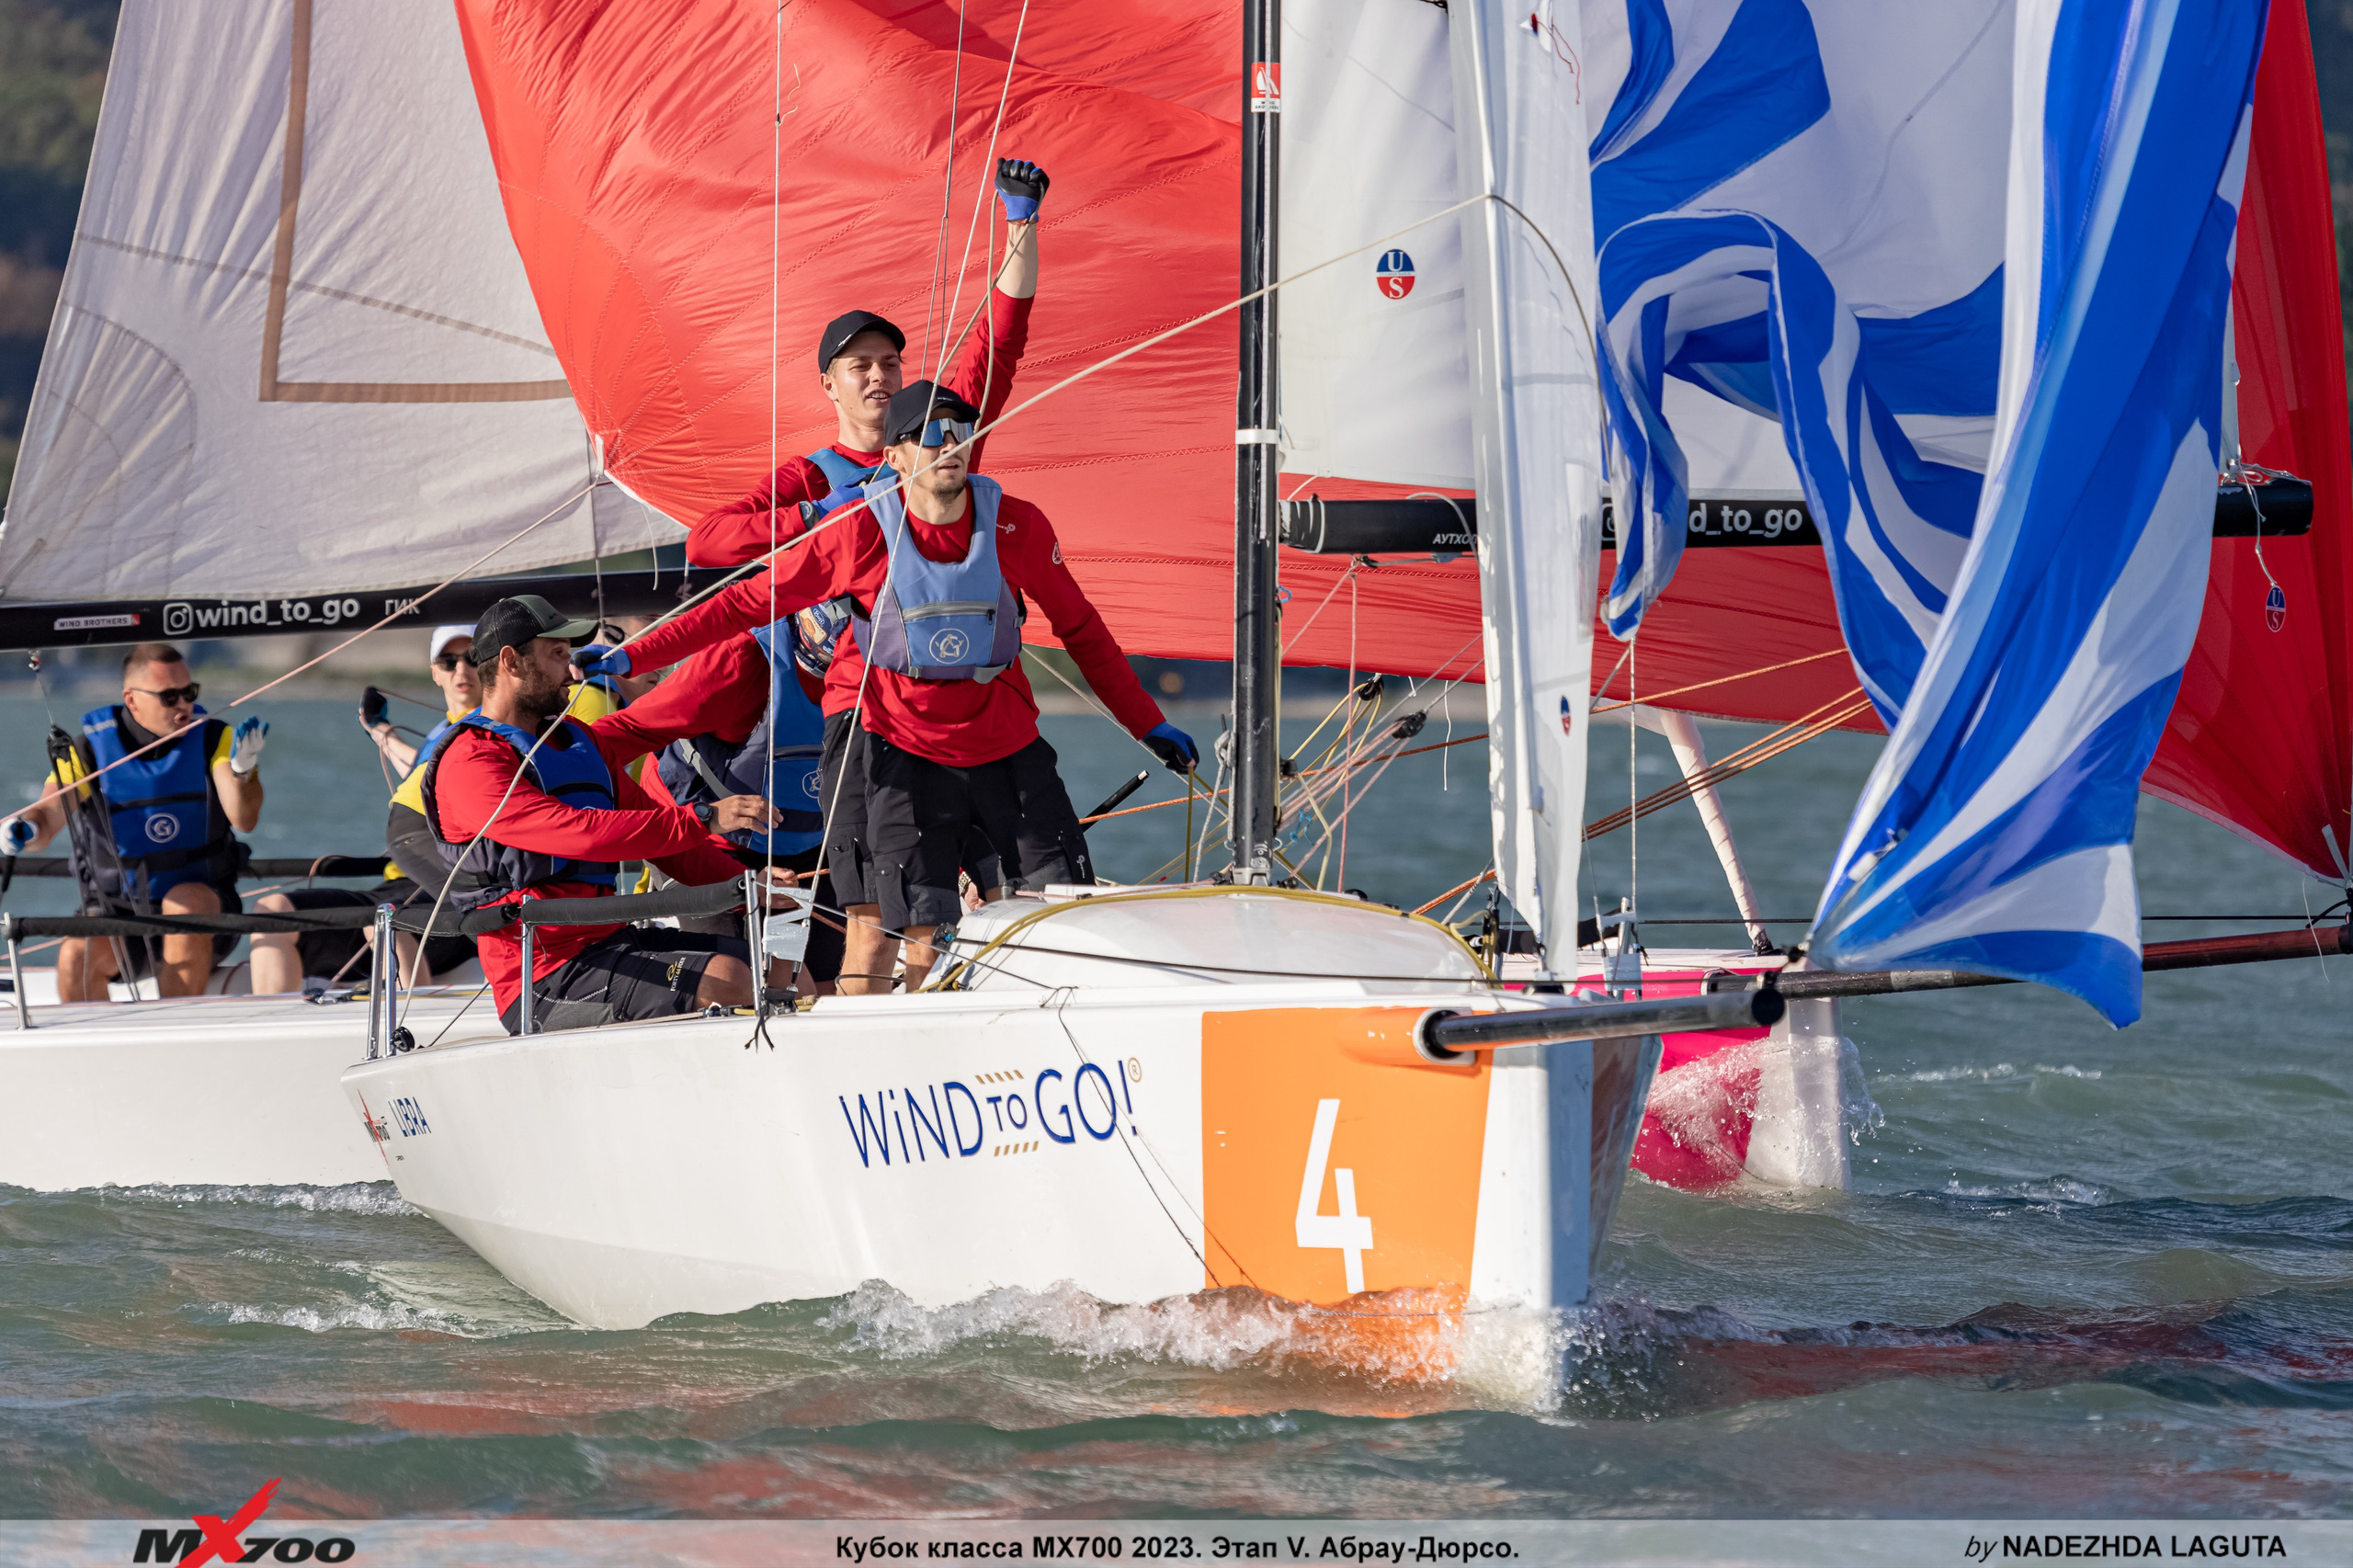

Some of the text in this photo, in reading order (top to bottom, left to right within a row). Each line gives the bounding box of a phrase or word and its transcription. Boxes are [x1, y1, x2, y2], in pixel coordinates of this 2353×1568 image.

[58, 617, 128, 629] WIND BROTHERS
[196, 598, 360, 628] wind_to_go
[1295, 1098, 1374, 1294] 4
